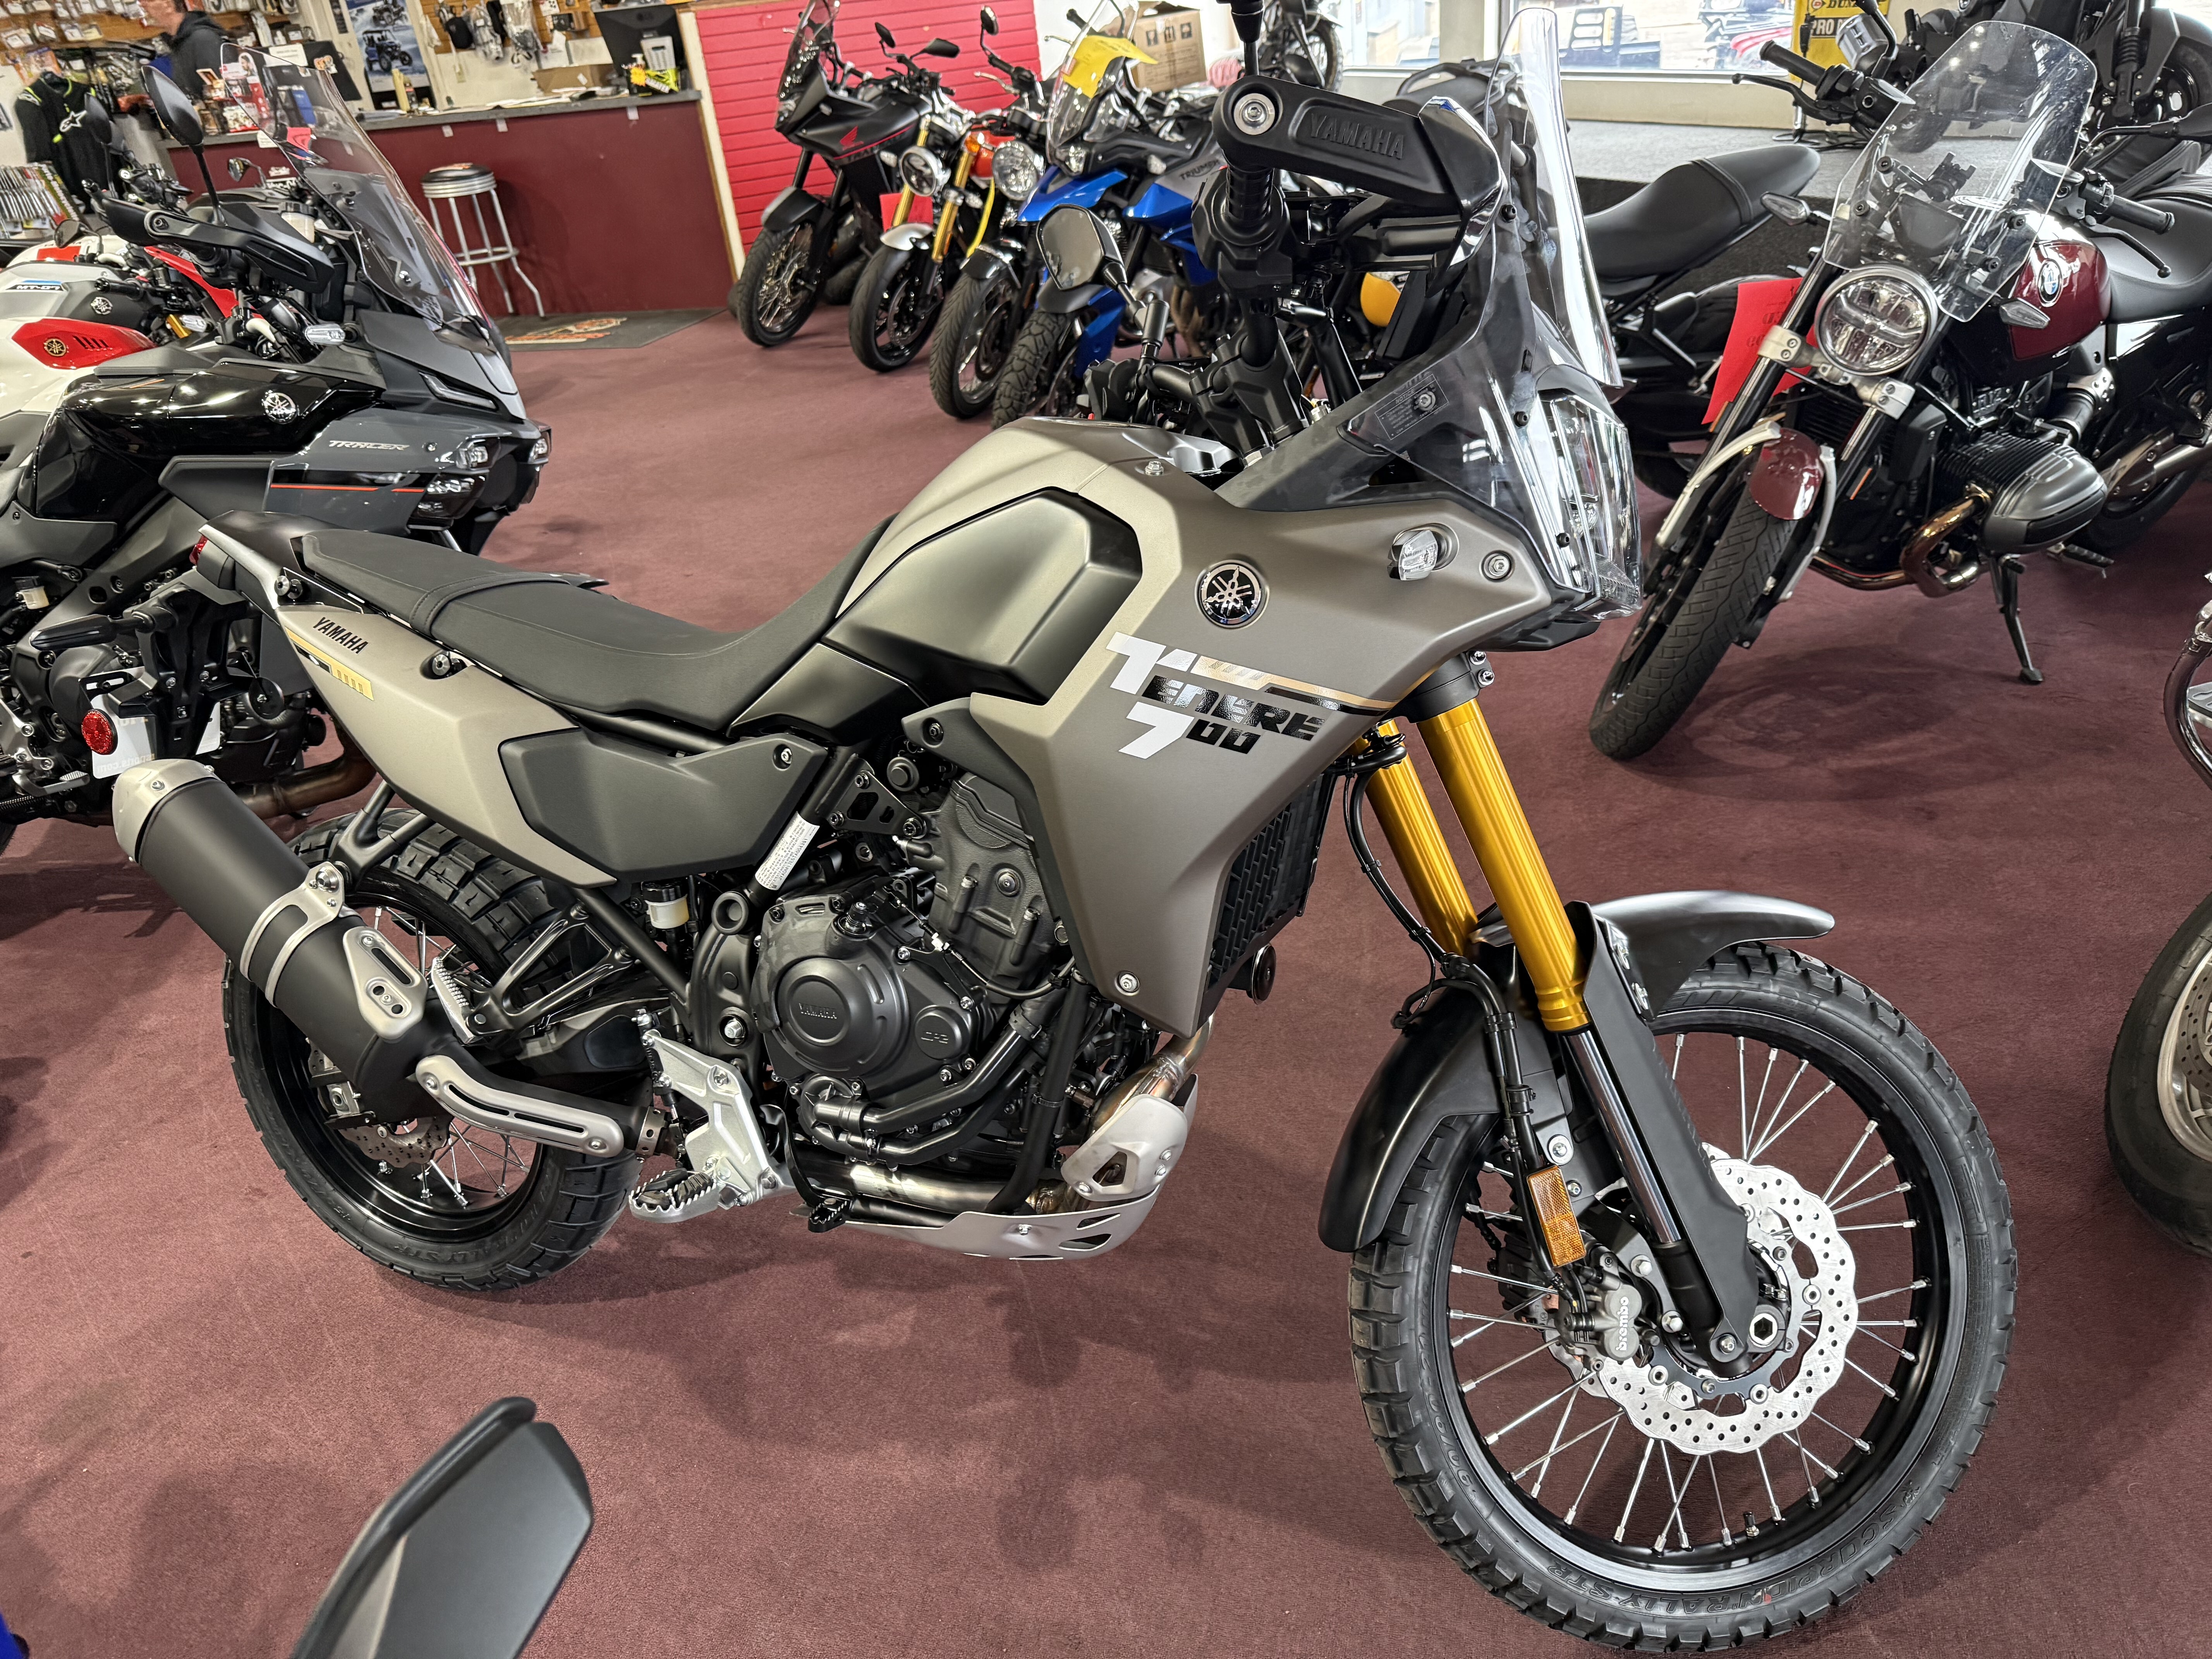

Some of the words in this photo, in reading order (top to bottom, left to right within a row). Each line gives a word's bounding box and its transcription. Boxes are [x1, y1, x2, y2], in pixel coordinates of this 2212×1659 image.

[1311, 113, 1404, 160] YAMAHA
[1179, 159, 1221, 180] TRIUMPH
[1395, 389, 1416, 404] NOTICE
[328, 440, 410, 451] TRACER
[313, 617, 370, 655] YAMAHA
[1118, 701, 1261, 759] 700
[798, 1002, 837, 1020] YAMAHA
[1615, 1296, 1630, 1352] brembo
[1738, 1504, 1898, 1606] SCORPION
[1546, 1561, 1616, 1600] STR
[1618, 1592, 1730, 1614] RALLY
